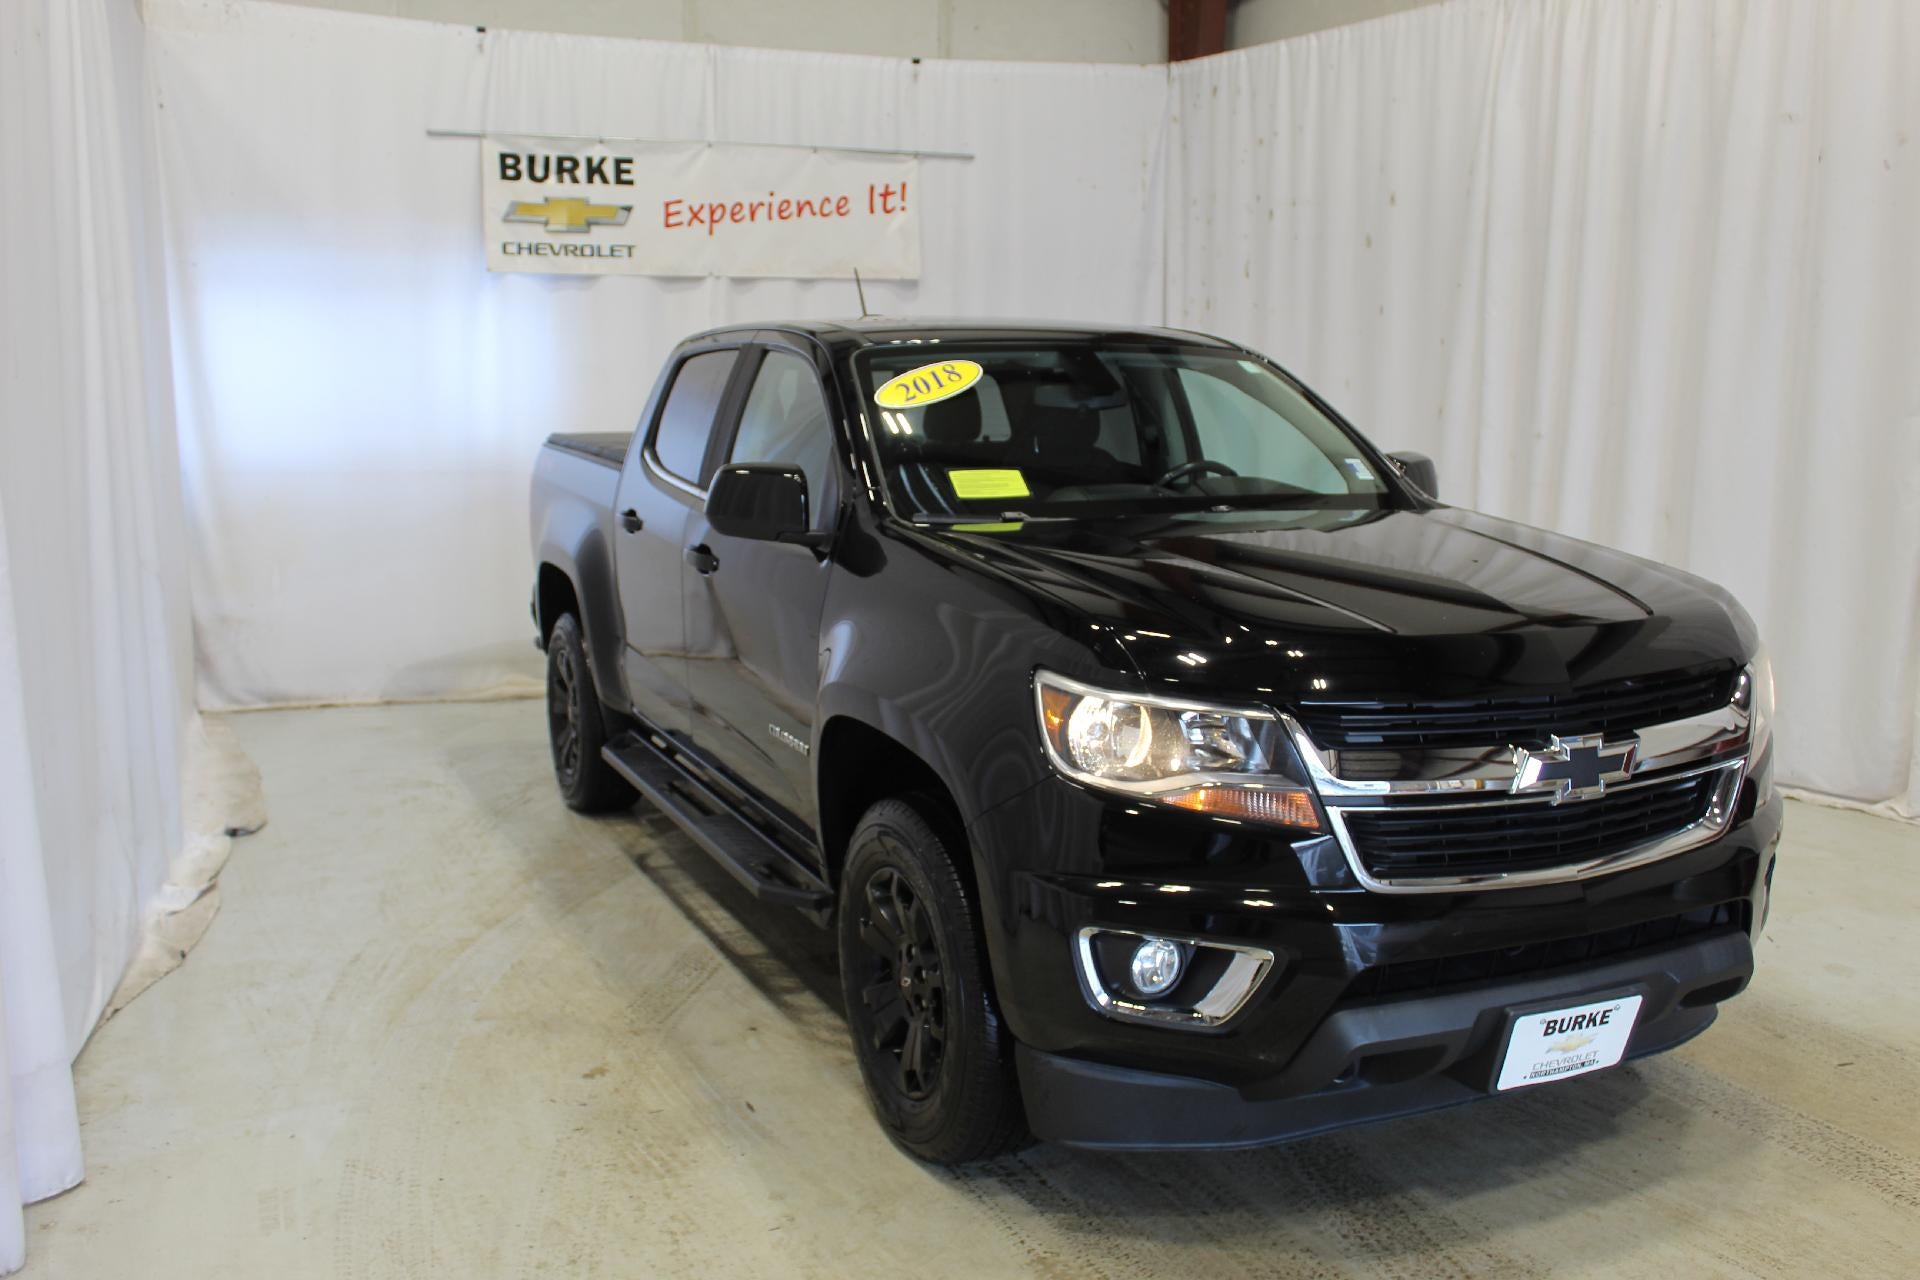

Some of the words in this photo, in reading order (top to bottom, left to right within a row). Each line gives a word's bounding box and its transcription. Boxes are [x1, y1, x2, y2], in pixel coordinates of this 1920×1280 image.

[498, 152, 635, 186] BURKE
[663, 191, 851, 236] Experience
[867, 181, 908, 216] It!
[501, 241, 637, 259] CHEVROLET
[895, 363, 963, 402] 2018
[1542, 1008, 1613, 1037] BURKE
[1531, 1050, 1600, 1071] CHEVROLET
